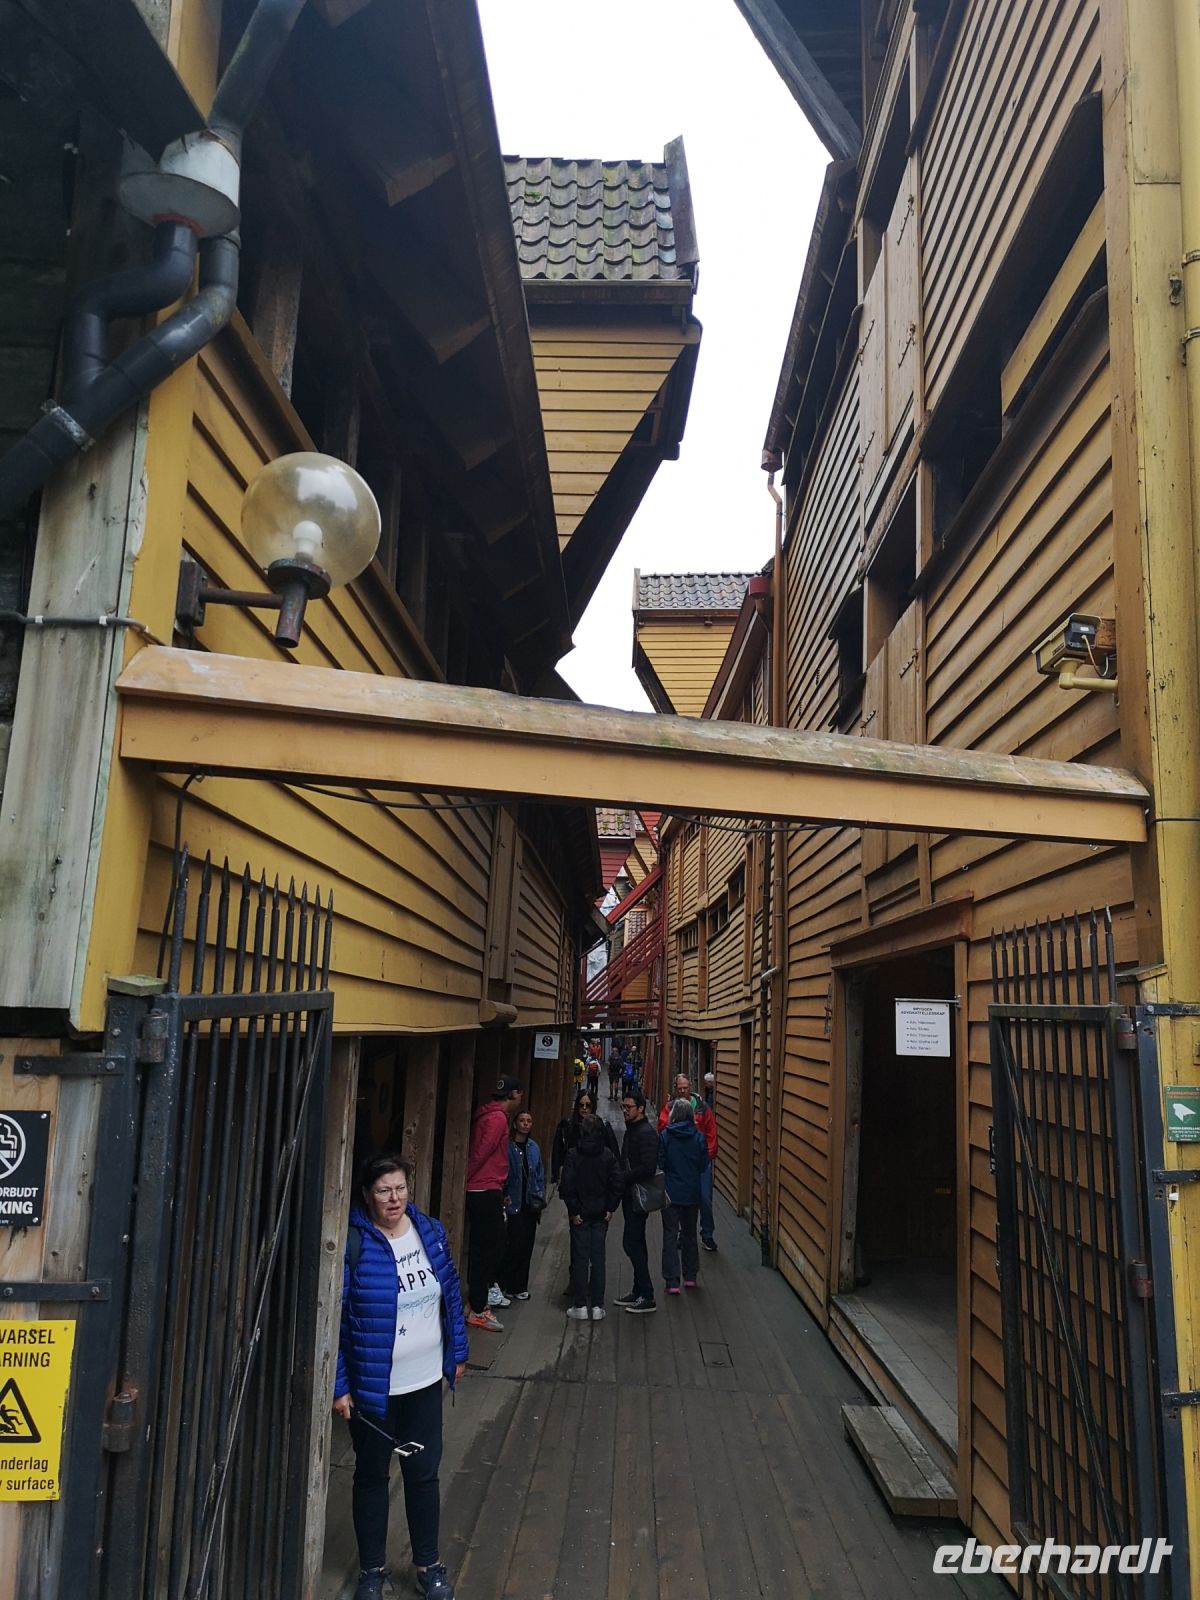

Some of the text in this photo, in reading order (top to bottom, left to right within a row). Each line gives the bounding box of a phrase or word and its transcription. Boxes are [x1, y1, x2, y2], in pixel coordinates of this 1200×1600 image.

[397, 1265, 439, 1293] APPY
[0, 1351, 51, 1368] RNING
[6, 1476, 55, 1490] surface
